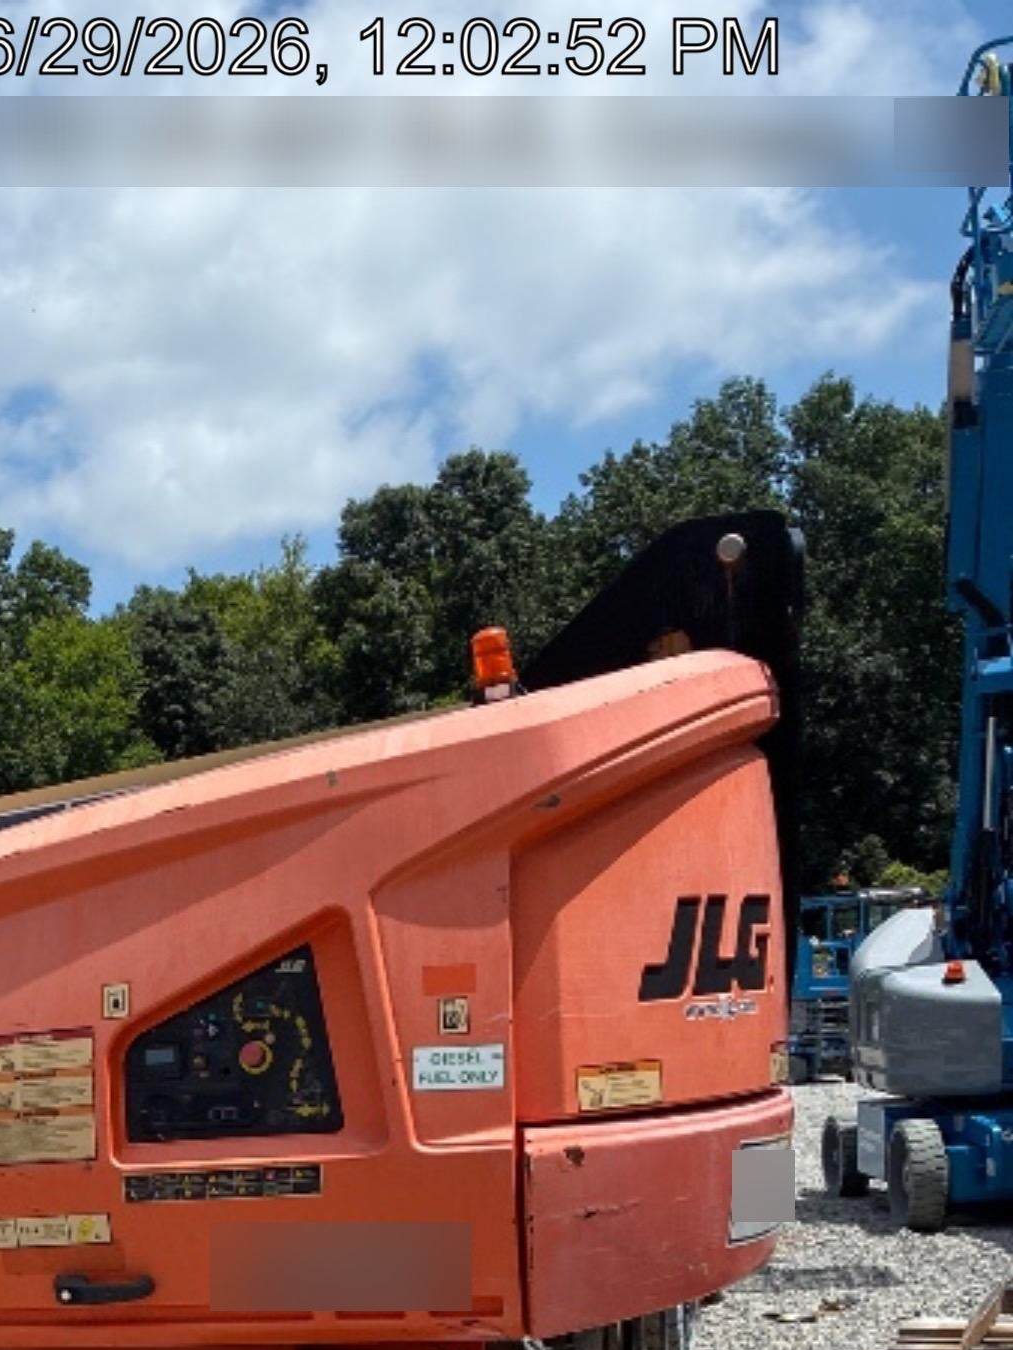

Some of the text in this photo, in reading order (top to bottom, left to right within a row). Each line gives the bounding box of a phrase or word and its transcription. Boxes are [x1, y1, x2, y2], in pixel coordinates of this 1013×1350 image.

[638, 893, 771, 1003] JLG
[429, 1051, 484, 1066] DIESEL
[419, 1070, 499, 1085] FUEL ONLY
